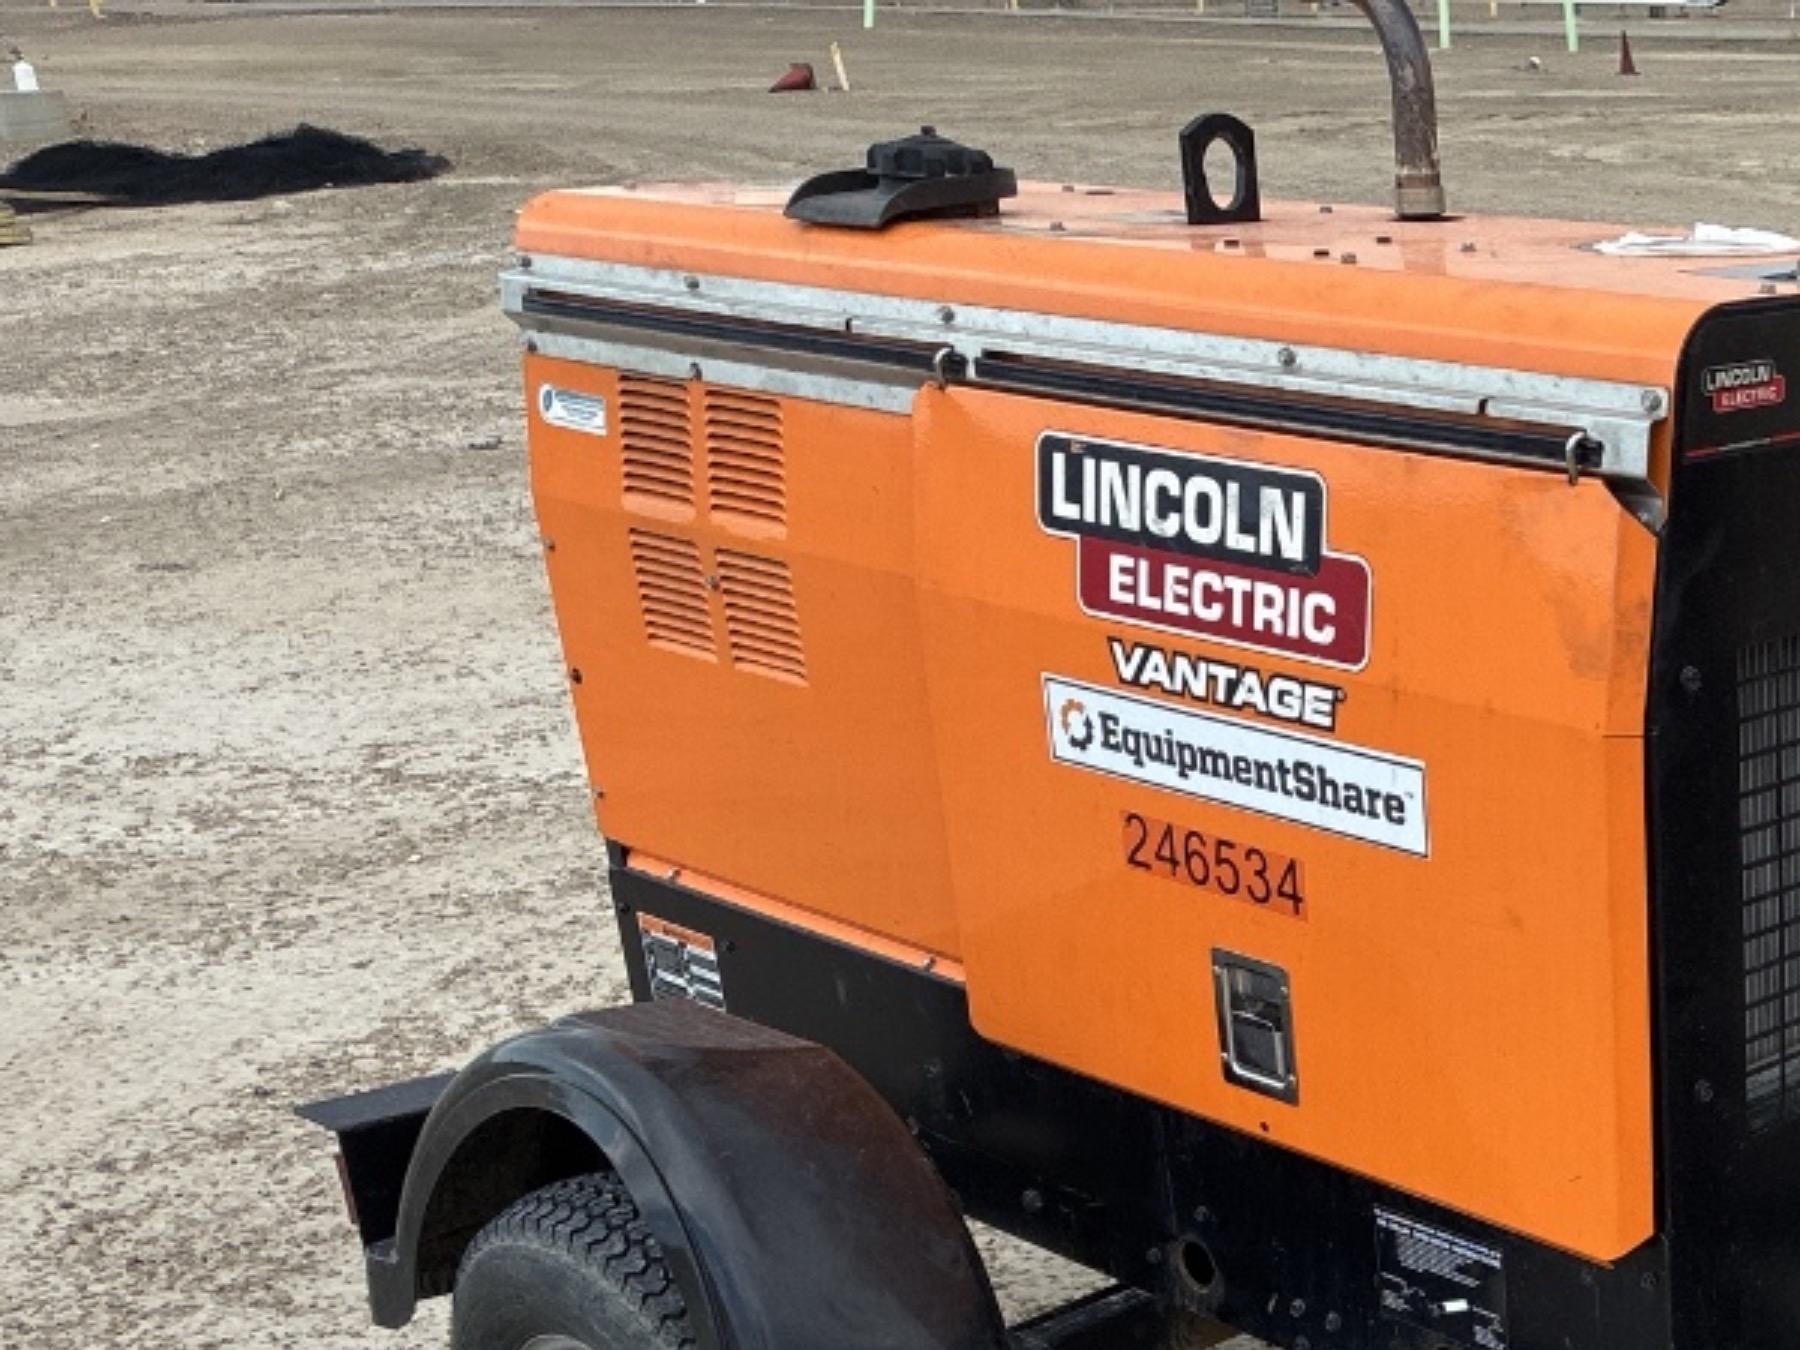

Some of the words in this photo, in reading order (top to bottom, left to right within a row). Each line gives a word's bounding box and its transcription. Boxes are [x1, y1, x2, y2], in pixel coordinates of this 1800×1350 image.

[1051, 451, 1307, 562] LINCOLN
[1108, 552, 1337, 646] ELECTRIC
[1109, 638, 1340, 729] VANTAGE
[1099, 710, 1406, 827] EquipmentShare
[1122, 811, 1304, 915] 246534
